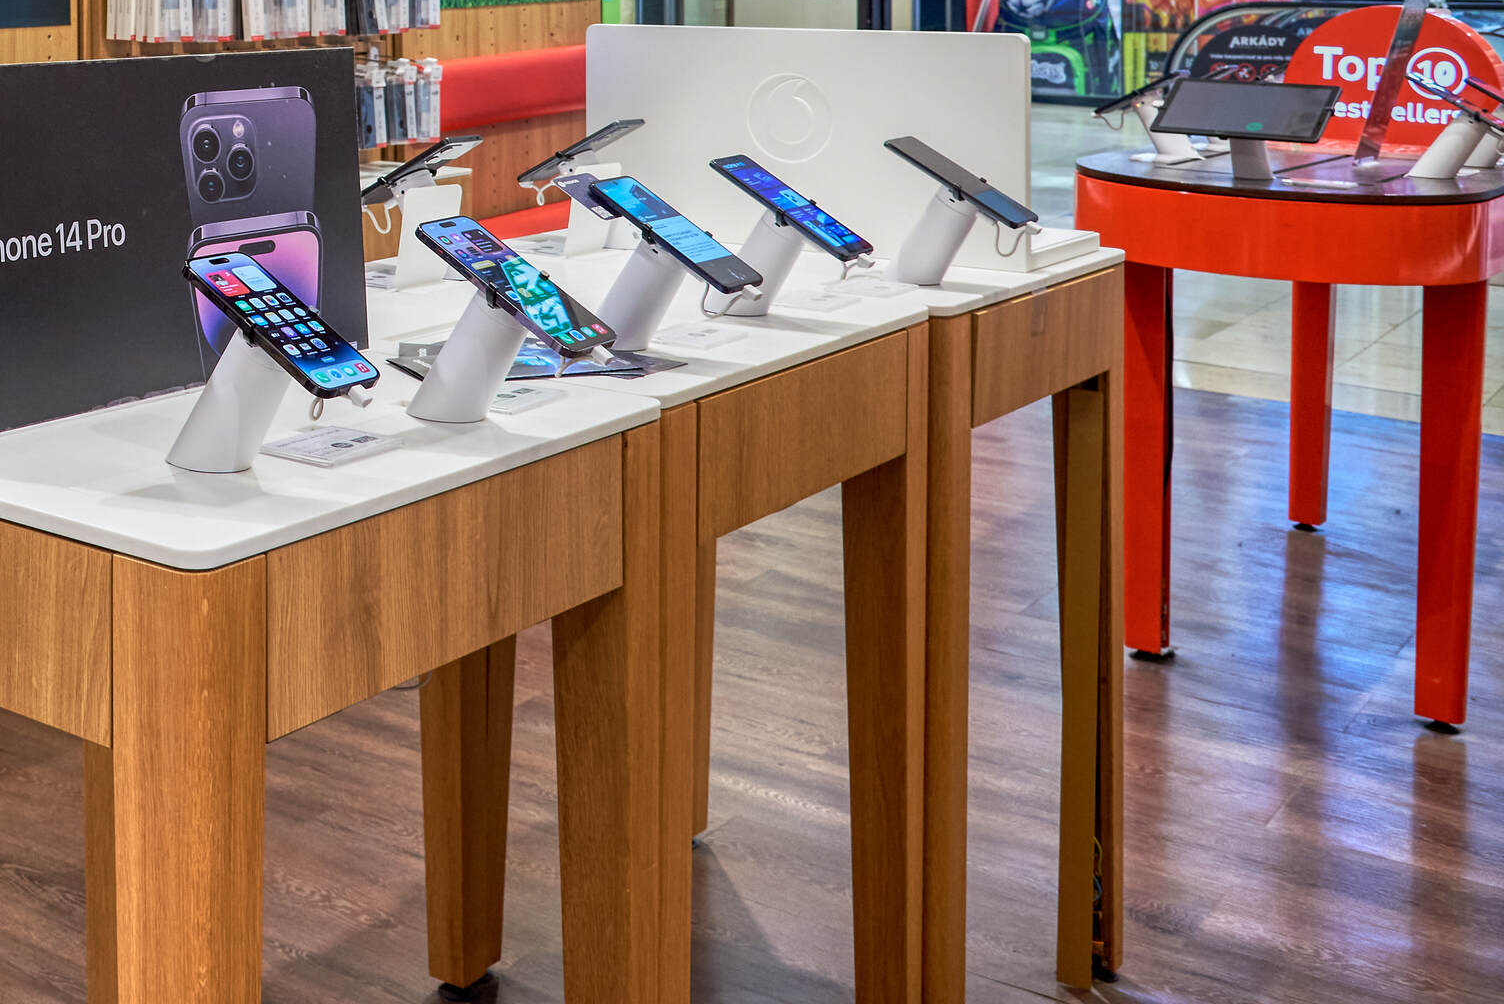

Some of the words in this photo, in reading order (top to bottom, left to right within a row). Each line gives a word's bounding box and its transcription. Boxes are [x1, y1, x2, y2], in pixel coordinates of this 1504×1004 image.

[1229, 34, 1286, 49] ARKÁDY
[1313, 45, 1388, 91] Top
[1417, 60, 1457, 88] 10
[55, 222, 83, 254] 14
[86, 218, 126, 250] Pro
